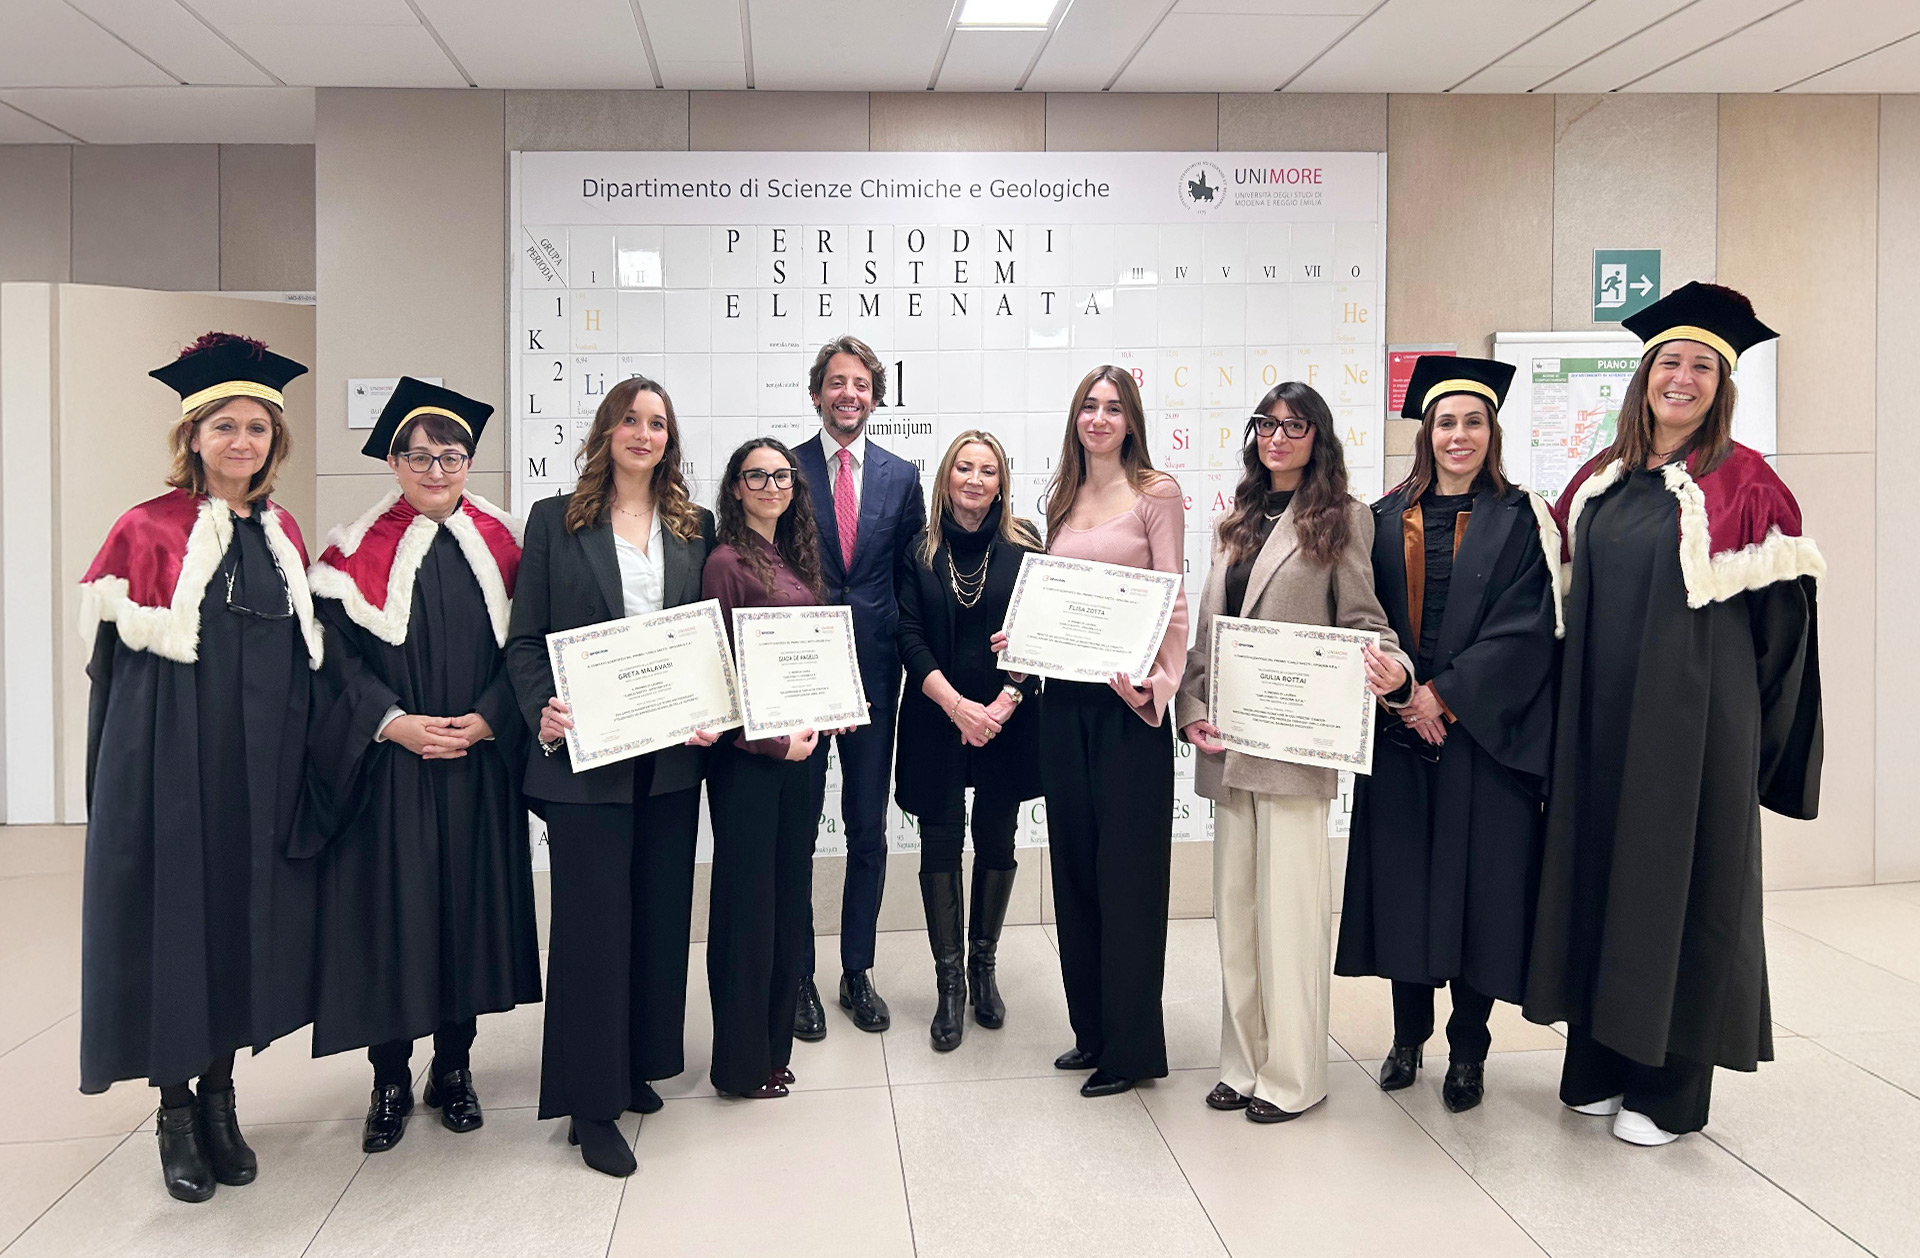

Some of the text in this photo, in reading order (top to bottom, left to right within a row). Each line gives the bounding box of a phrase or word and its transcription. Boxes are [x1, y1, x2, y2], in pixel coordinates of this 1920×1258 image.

[1235, 168, 1323, 185] UNIMORE
[583, 177, 1110, 203] Dipartimento di Scienze Chimiche e Geologiche
[1274, 191, 1293, 199] DEGLI
[1295, 191, 1313, 199] STUDI
[1315, 191, 1322, 199] DI
[1235, 199, 1264, 207] MODENA
[1273, 199, 1297, 207] REGGIO
[726, 228, 1053, 253] PERIODNI
[540, 238, 563, 266] GRUPA
[526, 246, 554, 282] PERIODA
[773, 259, 1016, 285] SISTEM
[1131, 267, 1145, 281] III
[1175, 266, 1188, 279] IV
[1221, 266, 1231, 278] V
[1263, 265, 1276, 279] VI
[1304, 265, 1321, 278] VII
[556, 296, 562, 317] 1
[725, 291, 1101, 319] ELEMENATA
[1344, 302, 1368, 324] He
[585, 309, 600, 331] H
[527, 329, 545, 350] K
[552, 360, 564, 382] 2
[1306, 363, 1320, 386] F
[1344, 364, 1369, 385] Ne
[1598, 360, 1627, 369] PIANO
[584, 372, 605, 396] Li
[1130, 367, 1144, 388] B
[1174, 366, 1188, 388] C
[1219, 366, 1233, 386] N
[1262, 364, 1279, 388] O
[529, 393, 542, 414] L
[554, 424, 564, 445] 3
[864, 419, 933, 440] luminijum
[1172, 428, 1190, 451] Si
[1220, 427, 1231, 449] P
[1343, 426, 1367, 447] Ar
[528, 457, 547, 478] M
[618, 668, 640, 681] GRETA
[1260, 673, 1281, 682] GIULIA
